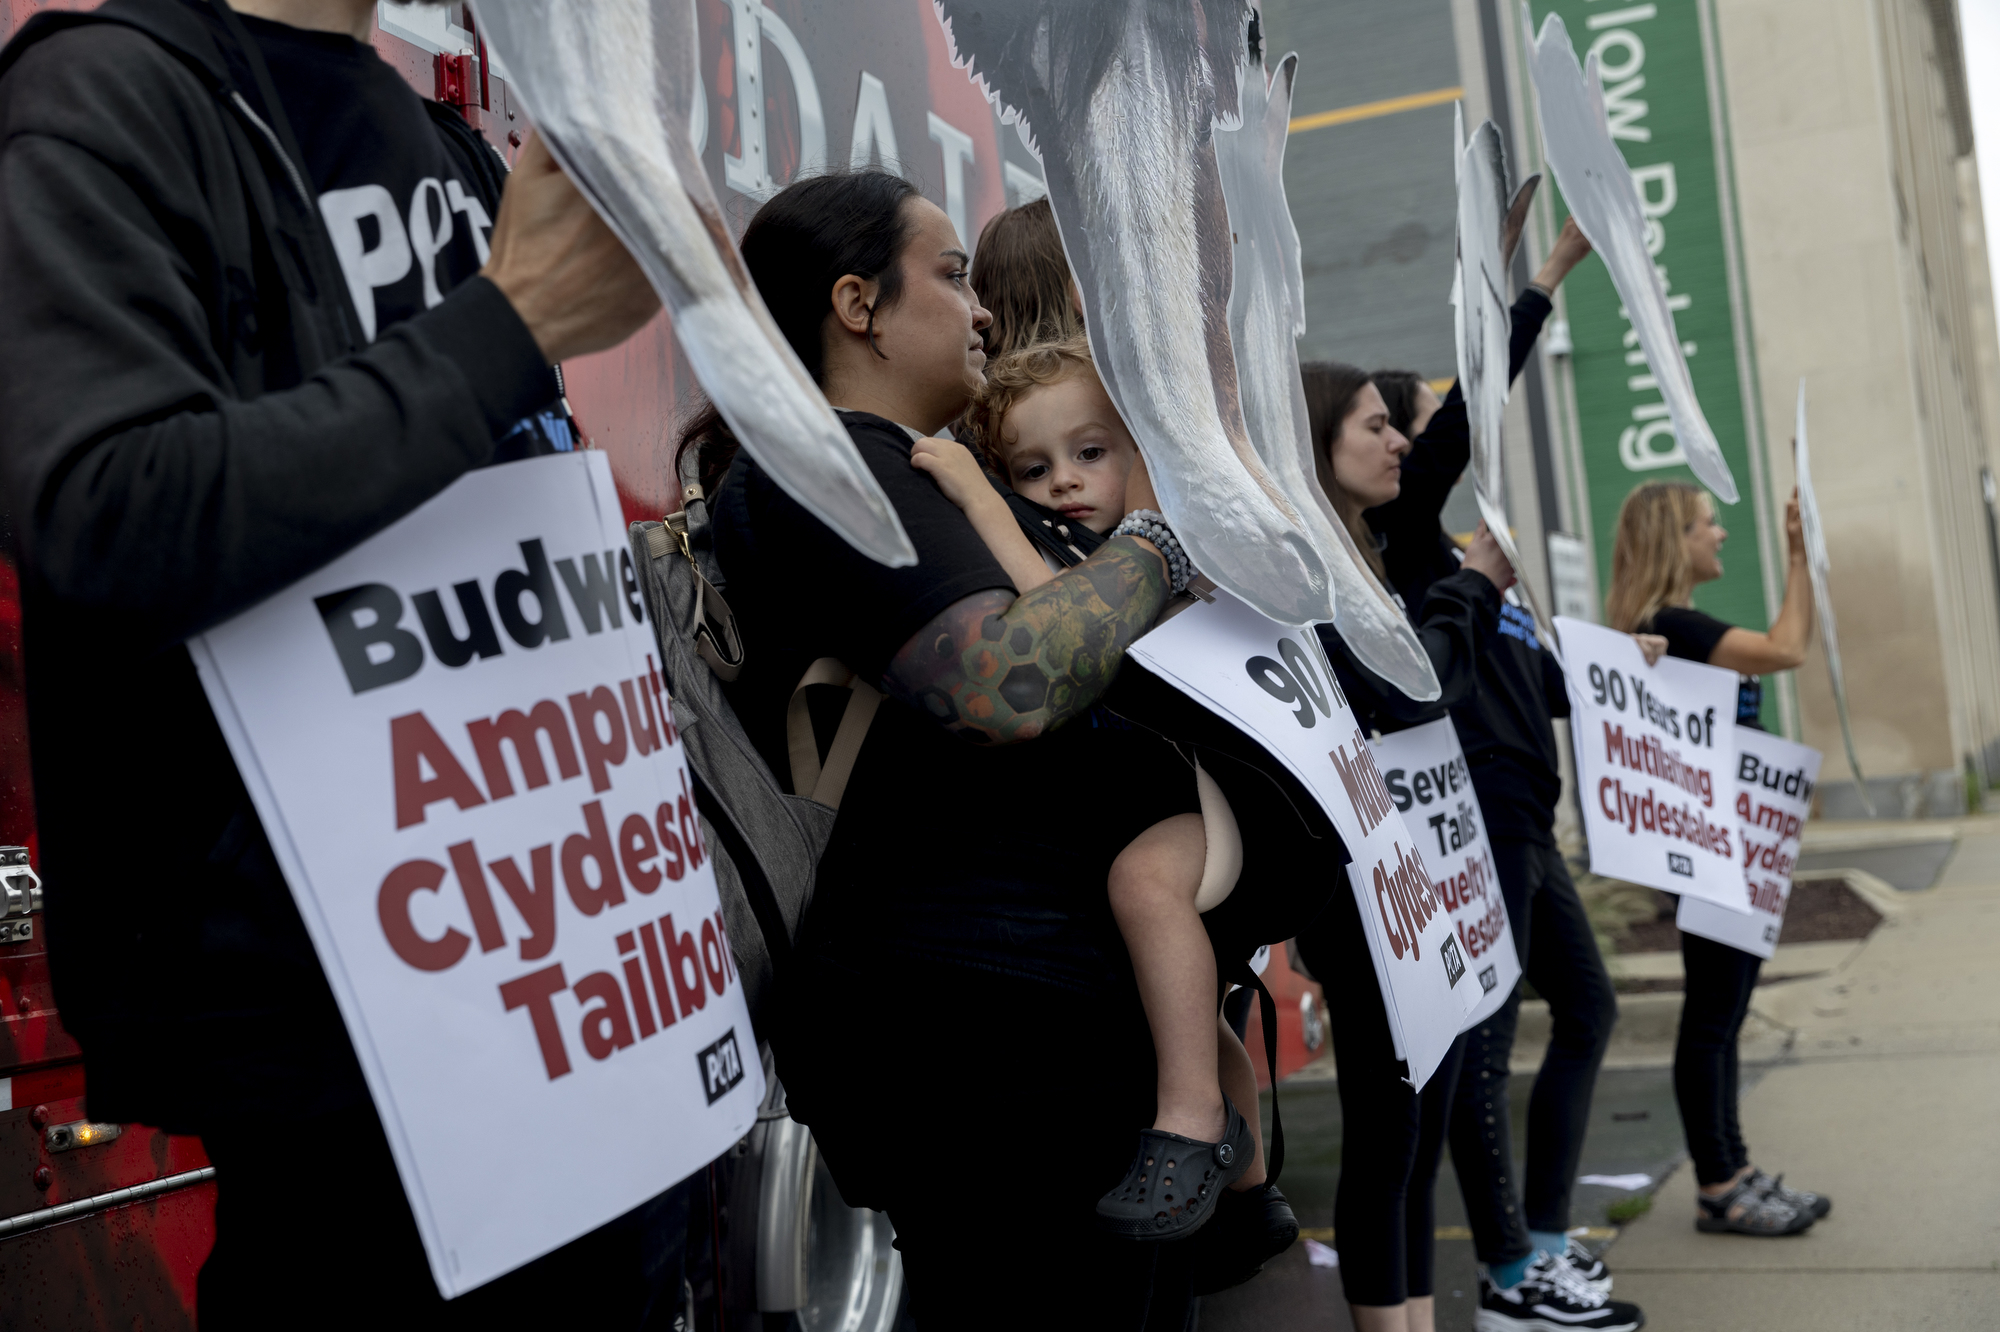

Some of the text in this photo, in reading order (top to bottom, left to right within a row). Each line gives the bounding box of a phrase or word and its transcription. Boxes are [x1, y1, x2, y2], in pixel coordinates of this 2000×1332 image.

[1585, 0, 1655, 143] low
[1245, 637, 1332, 729] 90
[1588, 663, 1627, 713] 90
[1629, 674, 1682, 739] Years
[1686, 707, 1716, 747] of
[1603, 719, 1714, 808] Mutilating
[376, 766, 707, 973] Clydesd
[1373, 841, 1442, 961] Clydes
